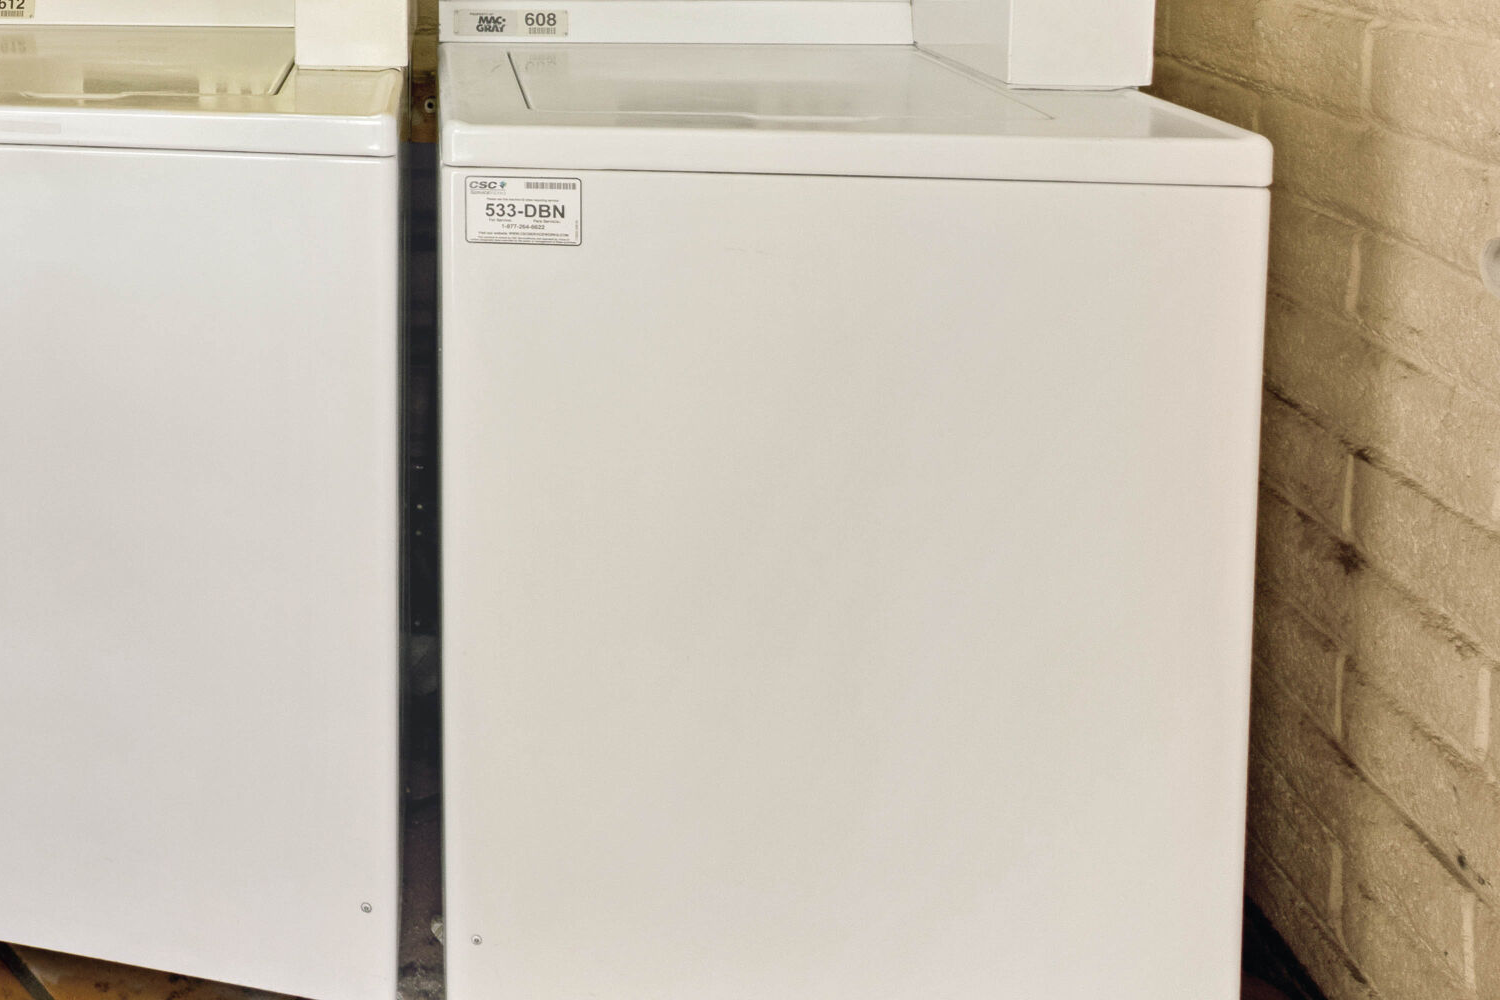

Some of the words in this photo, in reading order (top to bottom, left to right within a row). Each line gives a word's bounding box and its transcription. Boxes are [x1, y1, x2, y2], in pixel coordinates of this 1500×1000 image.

[524, 12, 556, 26] 608
[476, 24, 505, 32] GRAY
[469, 181, 497, 189] CSC
[485, 203, 564, 218] 533-DBN
